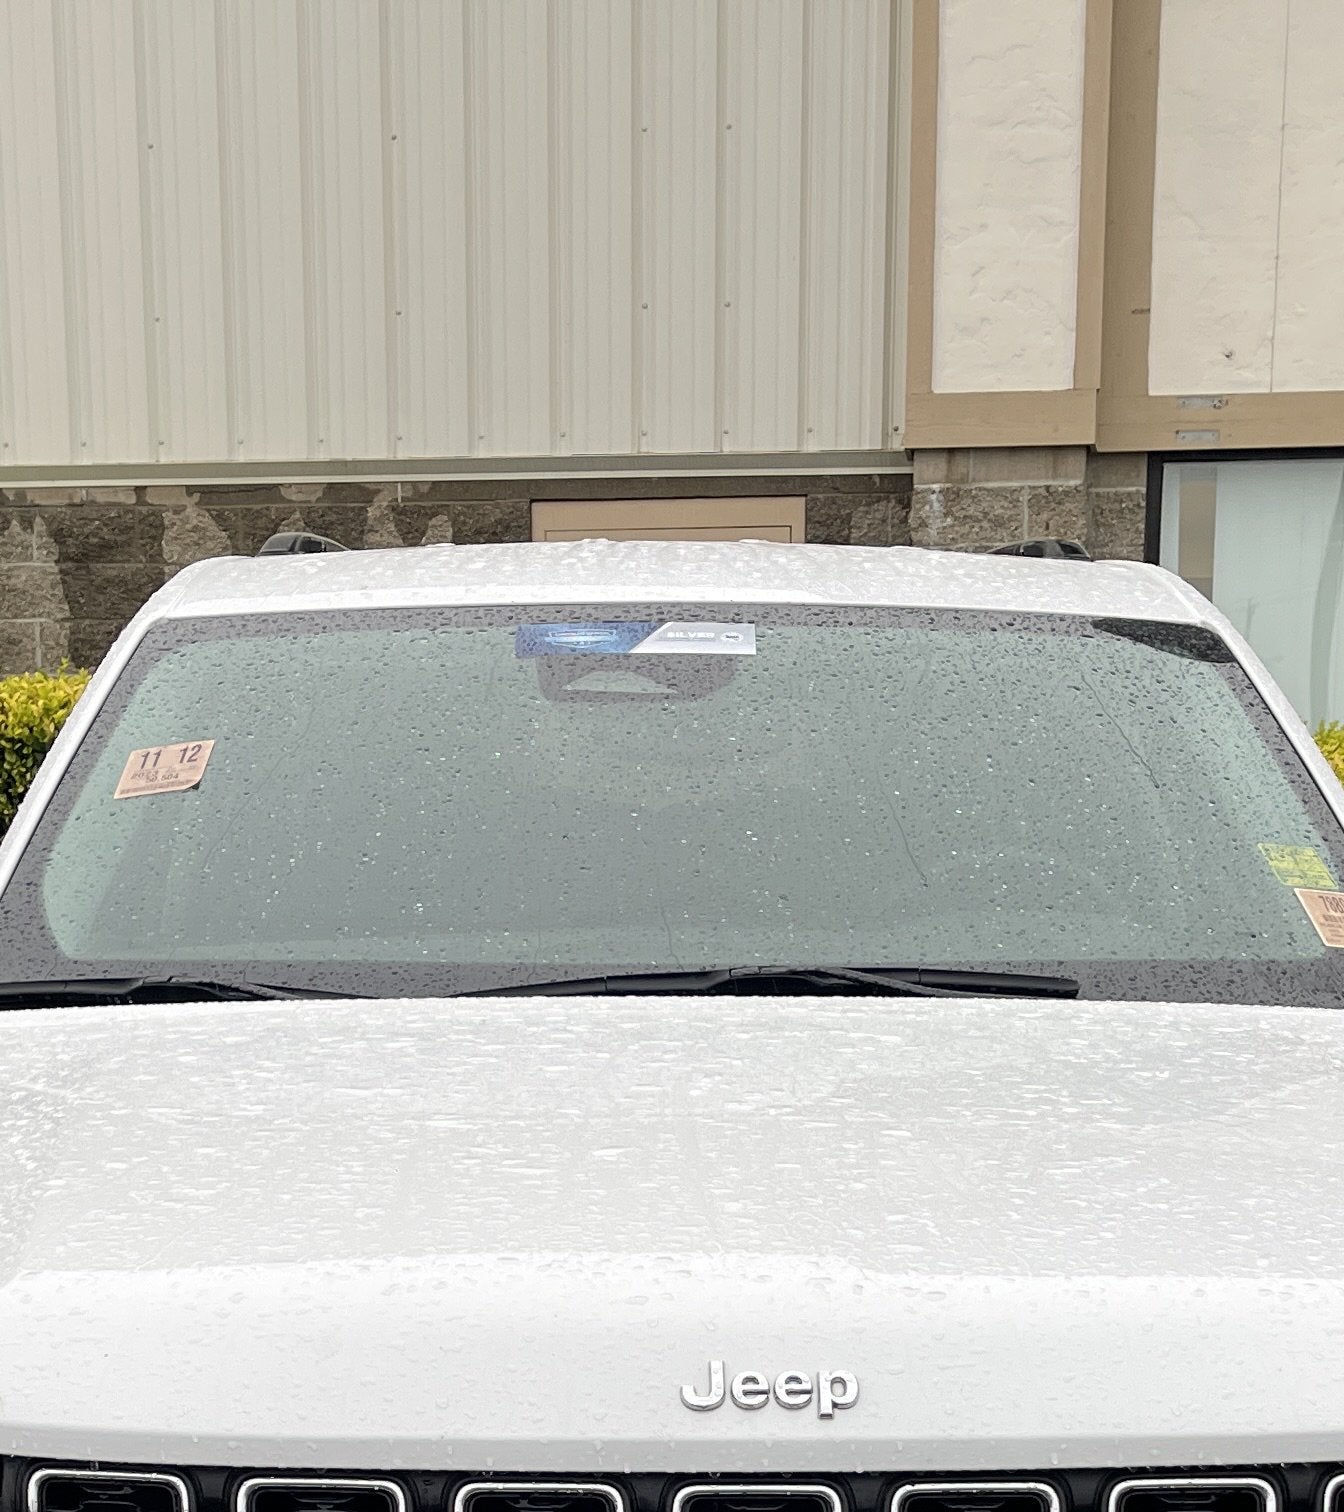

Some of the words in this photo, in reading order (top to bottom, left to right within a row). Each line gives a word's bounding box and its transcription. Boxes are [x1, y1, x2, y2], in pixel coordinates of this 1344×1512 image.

[140, 749, 163, 770] 11
[179, 743, 203, 764] 12
[680, 1359, 860, 1419] Jeep
